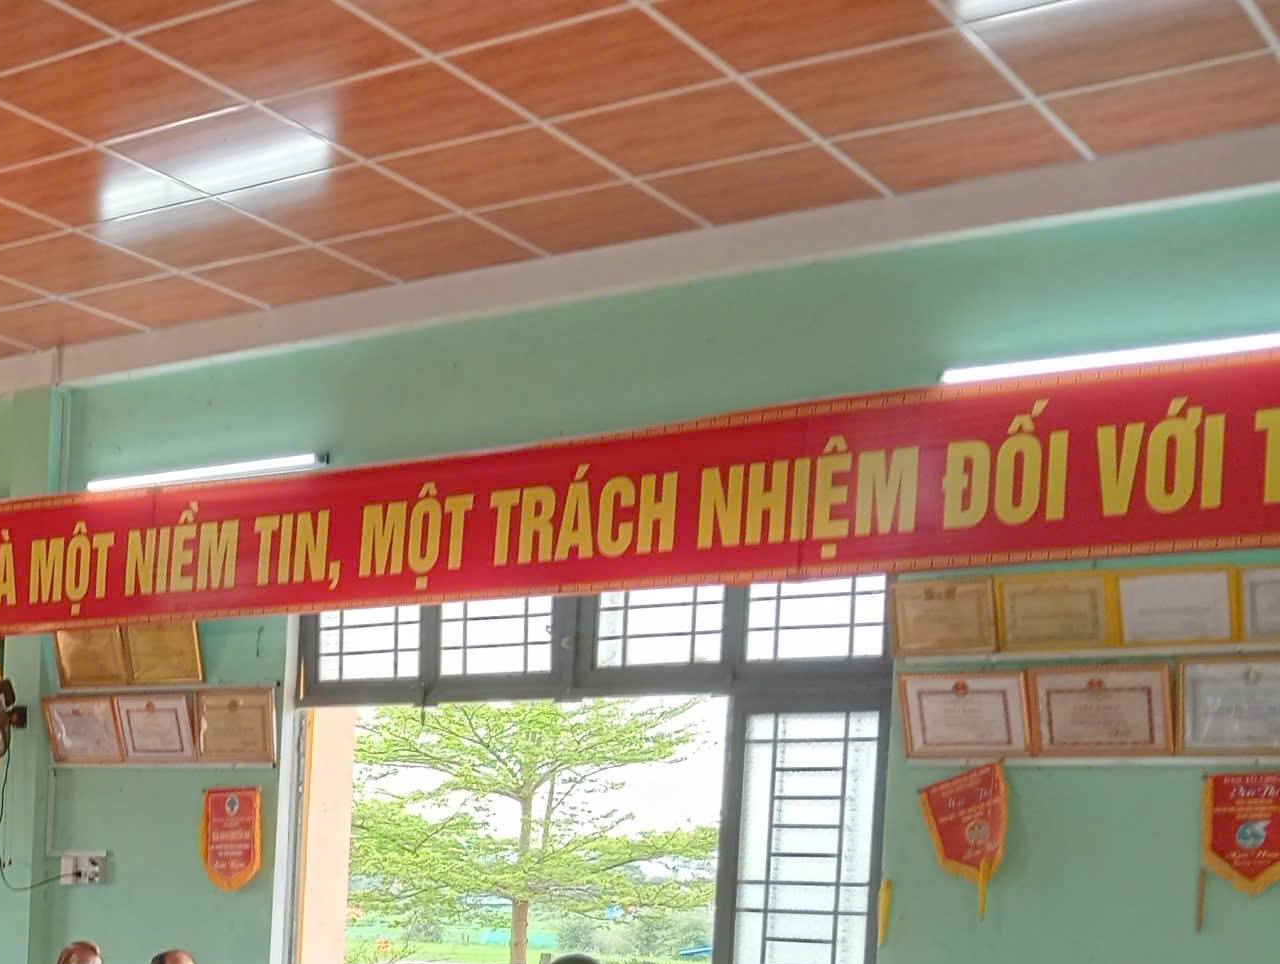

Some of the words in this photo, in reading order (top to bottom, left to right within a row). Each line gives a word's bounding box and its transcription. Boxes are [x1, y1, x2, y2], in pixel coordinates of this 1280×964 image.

[29, 521, 115, 616] MỘT
[124, 500, 239, 598] NIỀM
[255, 510, 340, 590] TIN,
[358, 481, 474, 591] MỘT
[490, 464, 679, 567] TRÁCH
[697, 434, 919, 560] NHIỆM
[942, 398, 1069, 530] ĐỐI
[1096, 396, 1226, 517] VỚI
